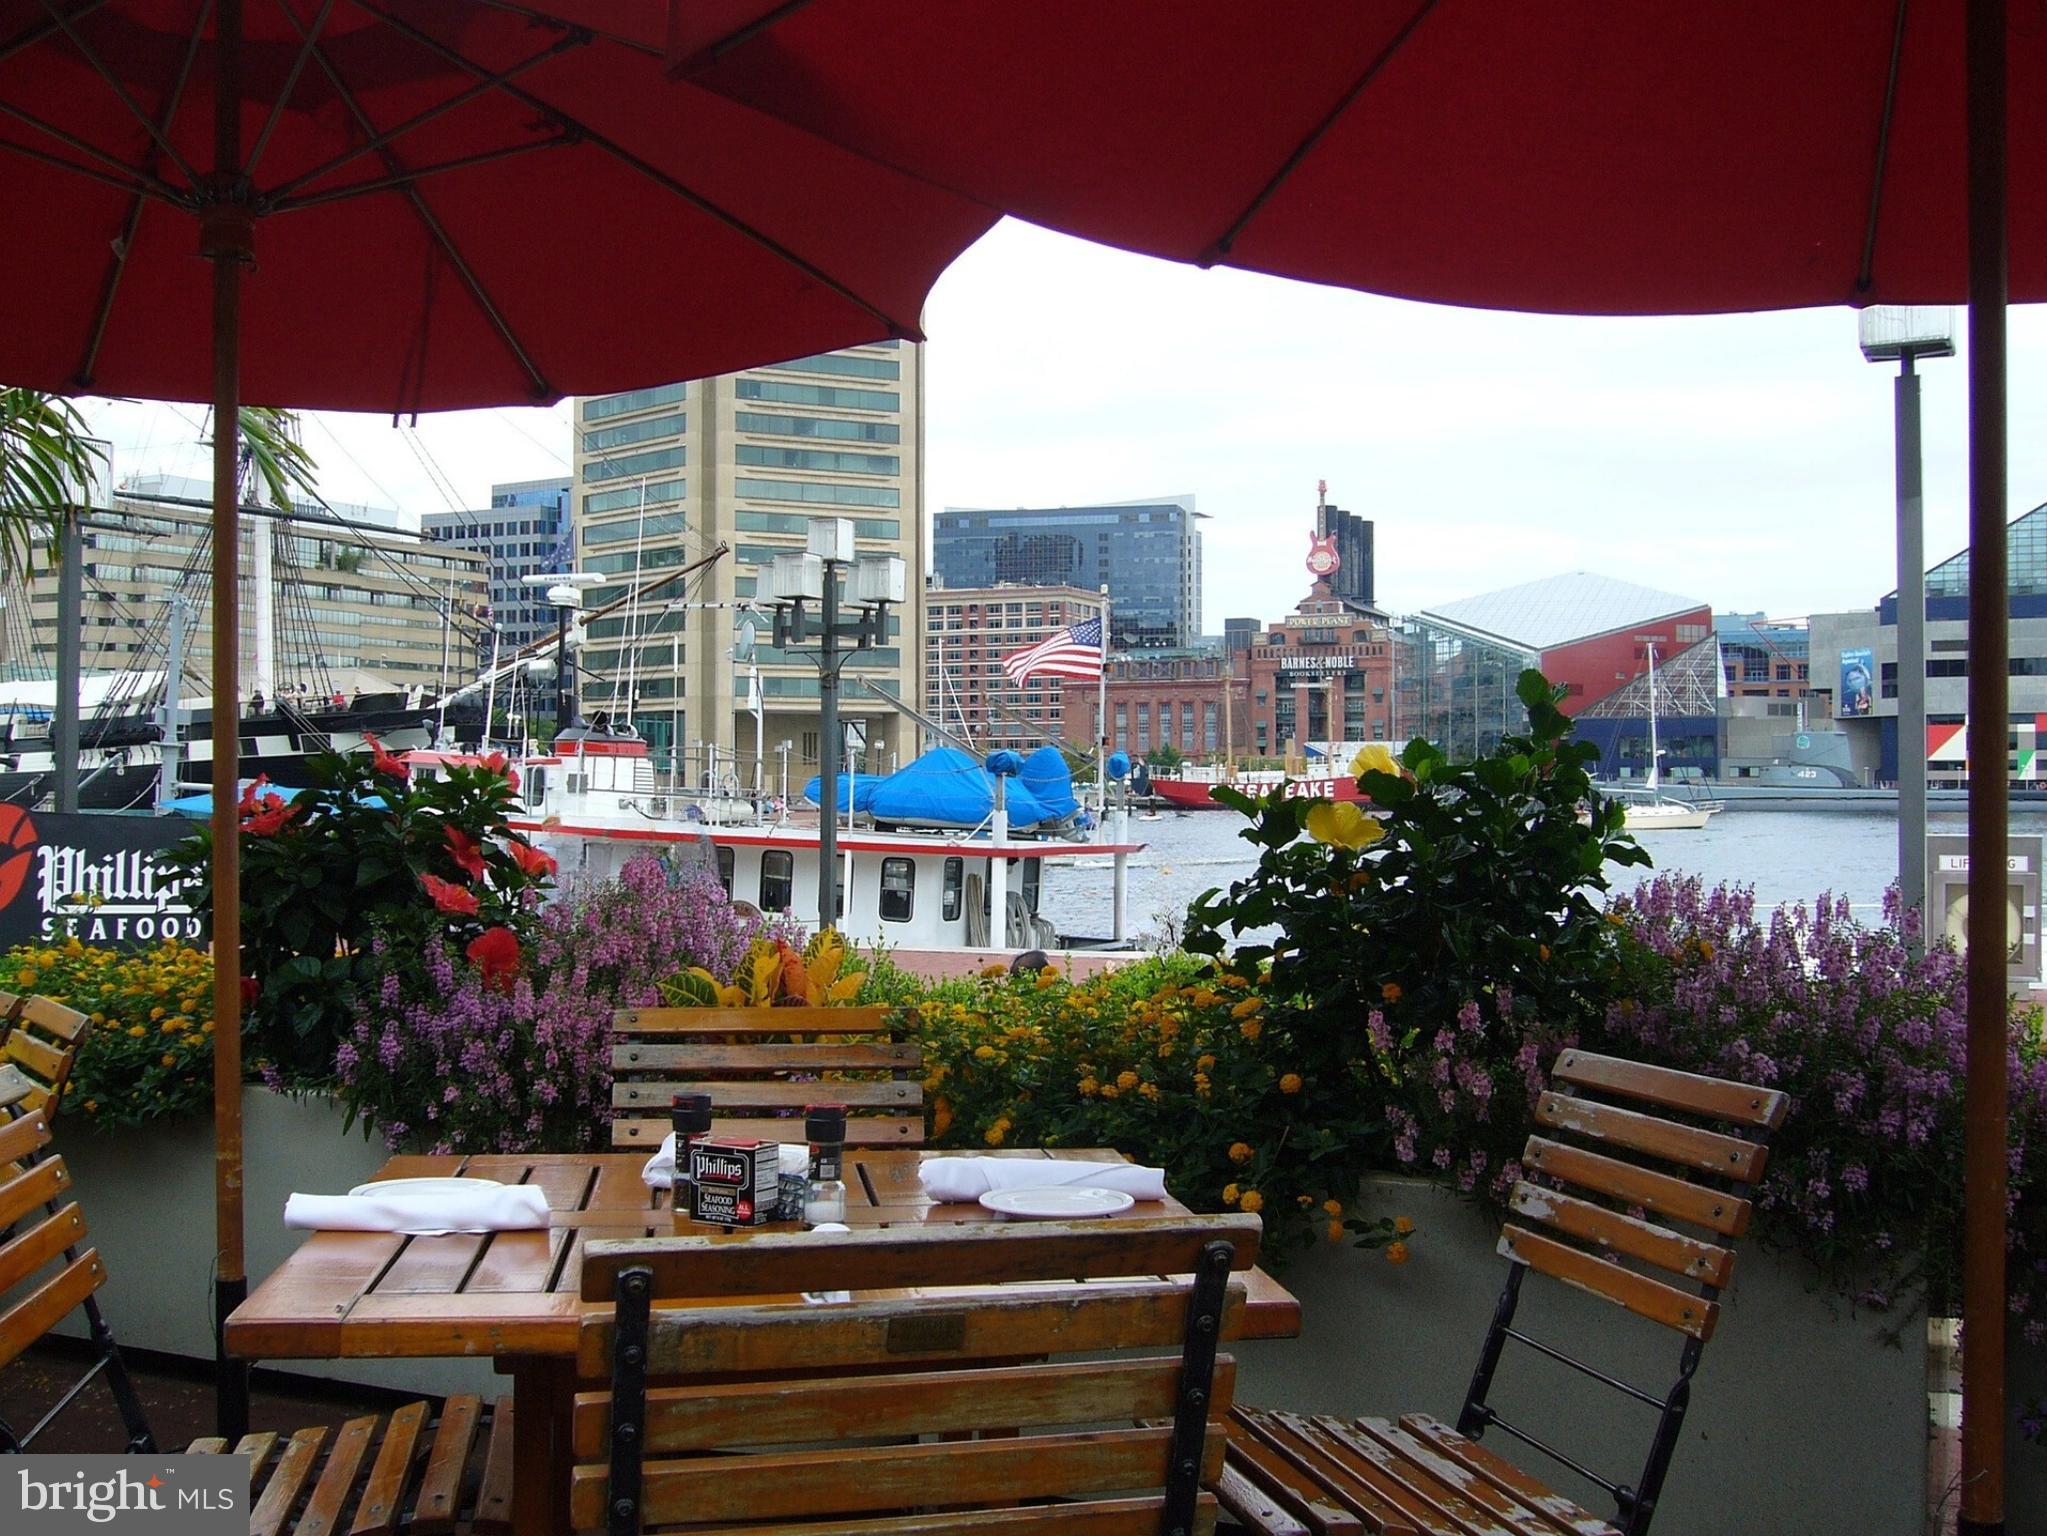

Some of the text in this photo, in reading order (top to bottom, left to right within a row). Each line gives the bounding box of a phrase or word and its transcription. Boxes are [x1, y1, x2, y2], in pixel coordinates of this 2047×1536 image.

[41, 917, 202, 941] SEAFOOD
[696, 1155, 742, 1180] Phillips
[701, 1201, 736, 1216] SEASONING
[703, 1193, 733, 1206] SEAFOOD
